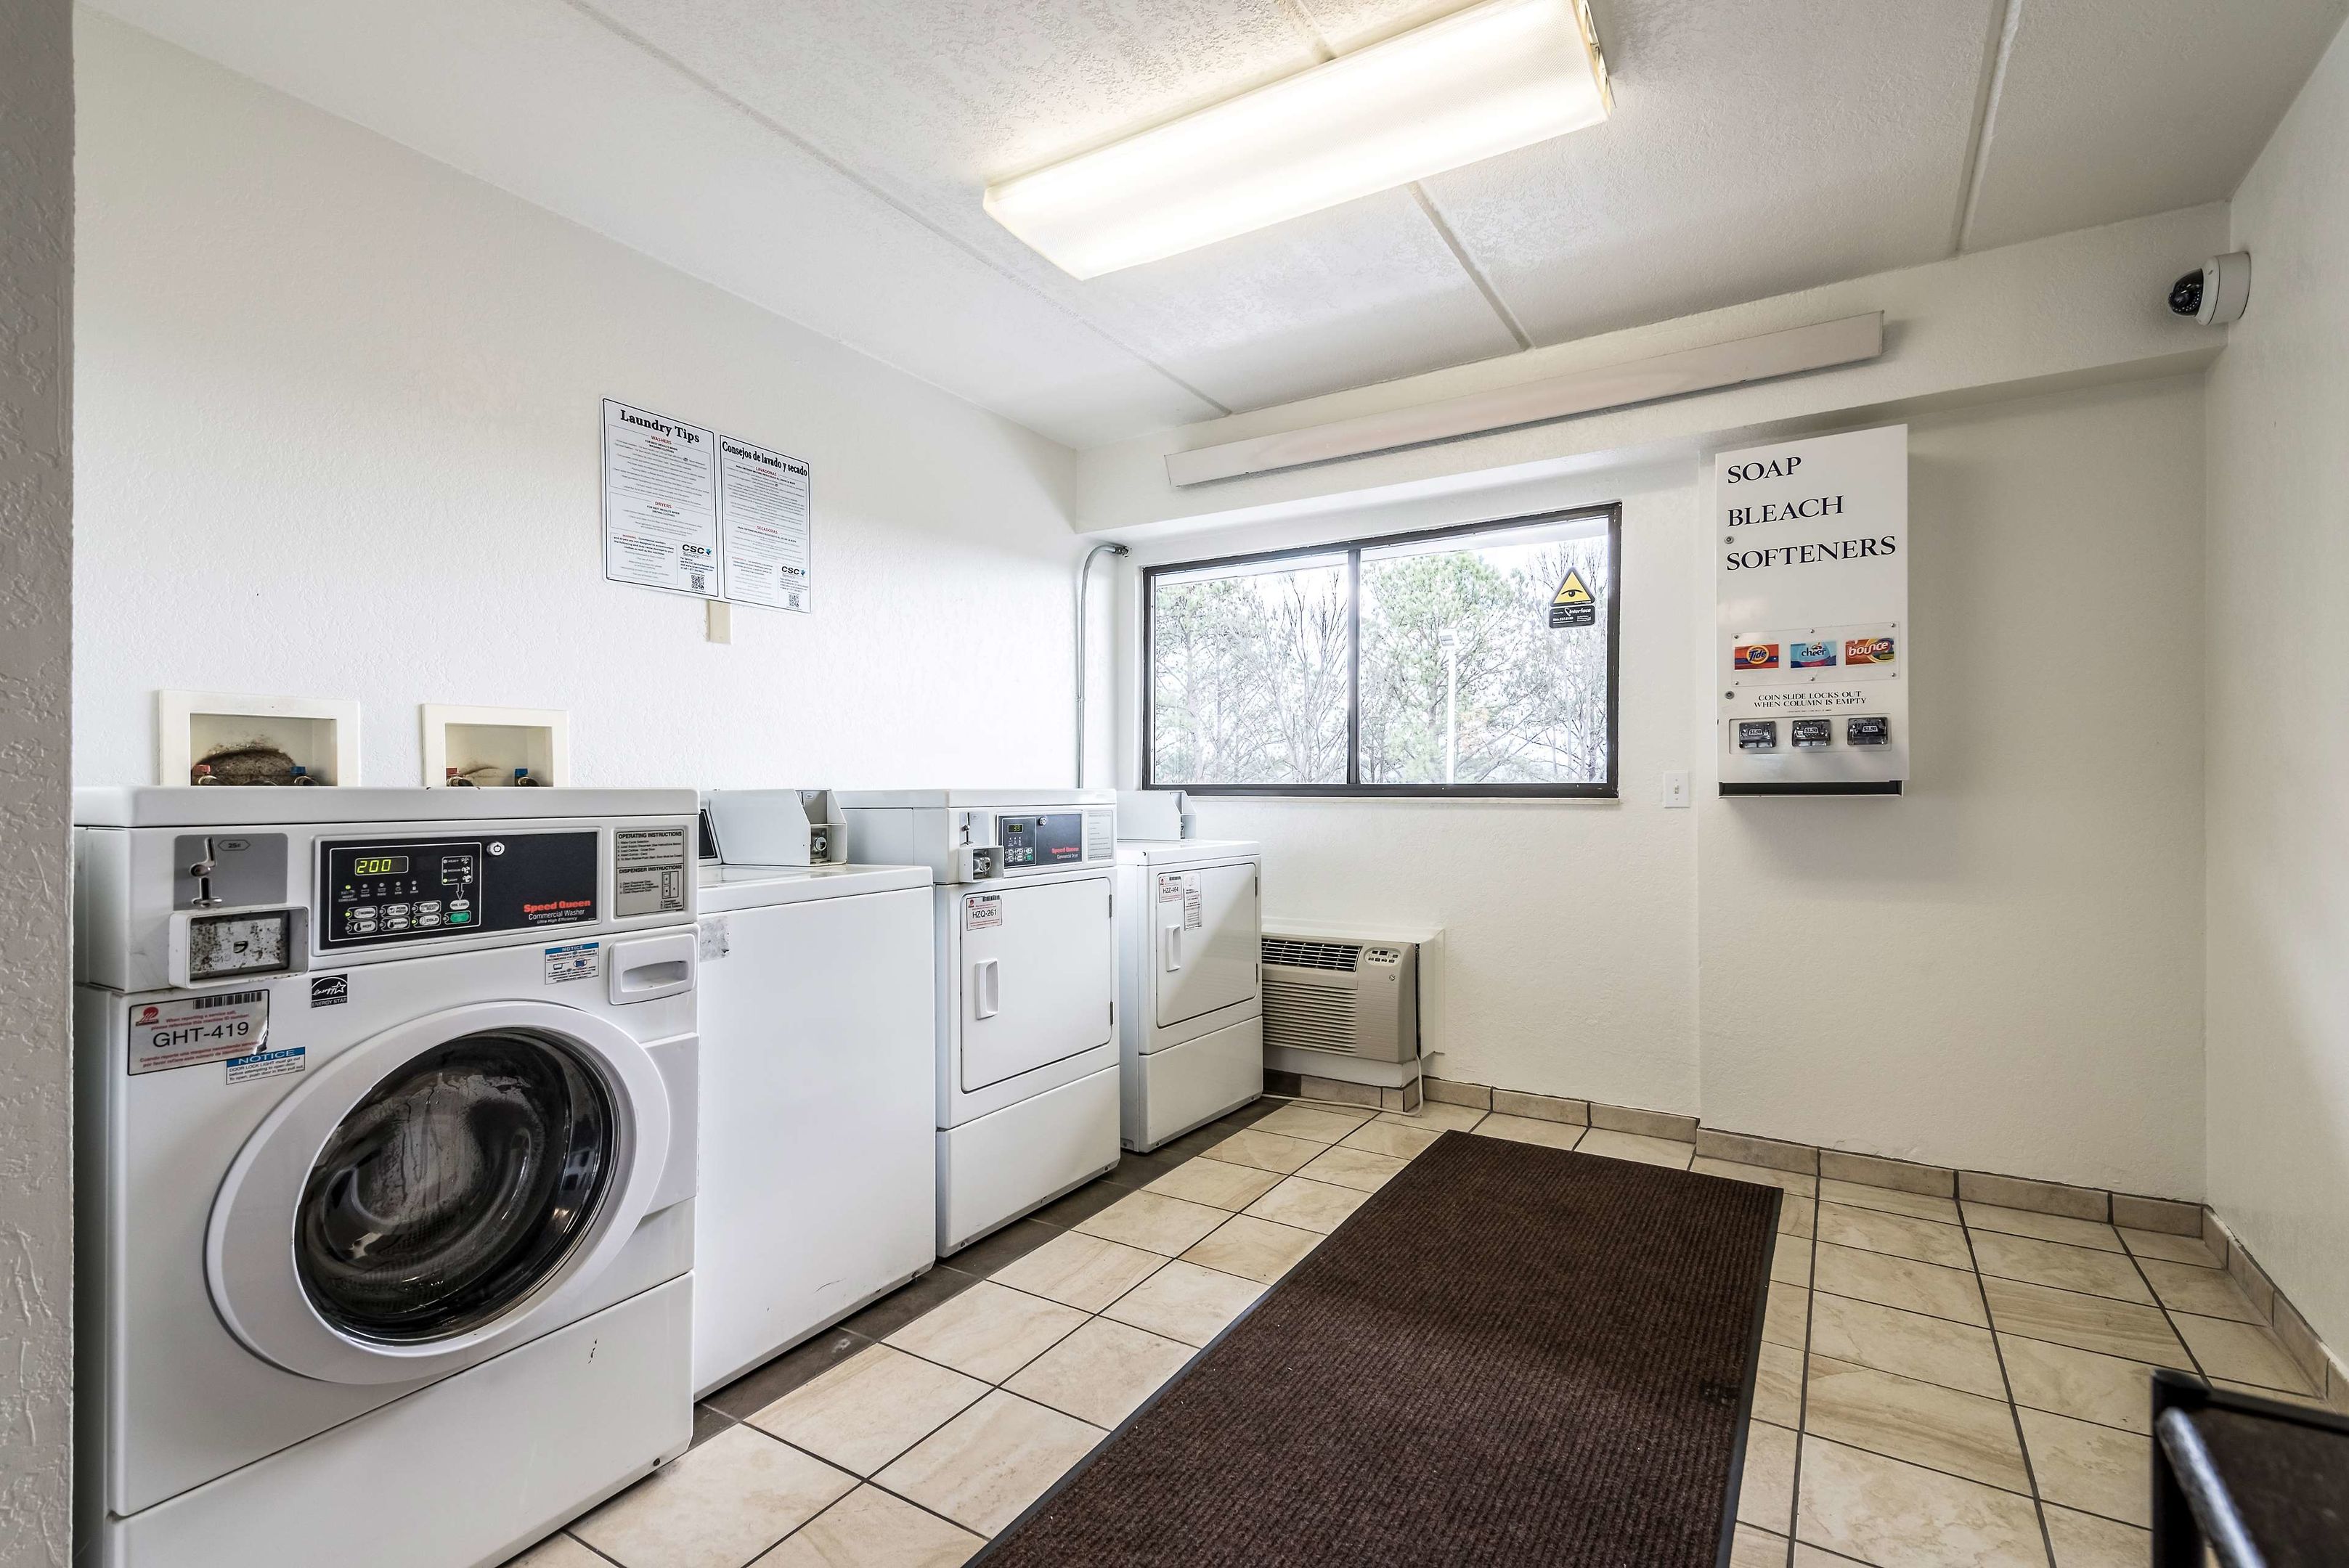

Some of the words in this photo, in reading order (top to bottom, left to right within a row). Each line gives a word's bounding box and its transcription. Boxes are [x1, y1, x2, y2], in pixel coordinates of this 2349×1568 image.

[620, 409, 672, 436] Laundry
[675, 426, 700, 444] Tips
[651, 436, 672, 444] WASHERS
[722, 441, 752, 459] Consejos
[753, 451, 761, 462] de
[762, 453, 781, 468] lavado
[783, 462, 786, 473] y
[788, 465, 807, 476] secado
[756, 467, 777, 476] LAVADORAS
[1727, 457, 1802, 483] SOAP
[1727, 495, 1844, 527] BLEACH
[757, 526, 778, 534] SECADORAS
[683, 544, 704, 554] CSC
[1727, 536, 1896, 571] SOFTENERS
[781, 566, 799, 575] CSC
[1802, 648, 1826, 657] cheer
[1849, 642, 1889, 656] bounce
[1749, 650, 1767, 661] Tide
[357, 859, 391, 873] 200
[524, 902, 557, 913] Speed
[529, 910, 563, 920] Commercial
[972, 909, 996, 918] HZQ-261
[152, 1021, 249, 1048] GHT-419
[238, 1050, 295, 1064] NOTICE
